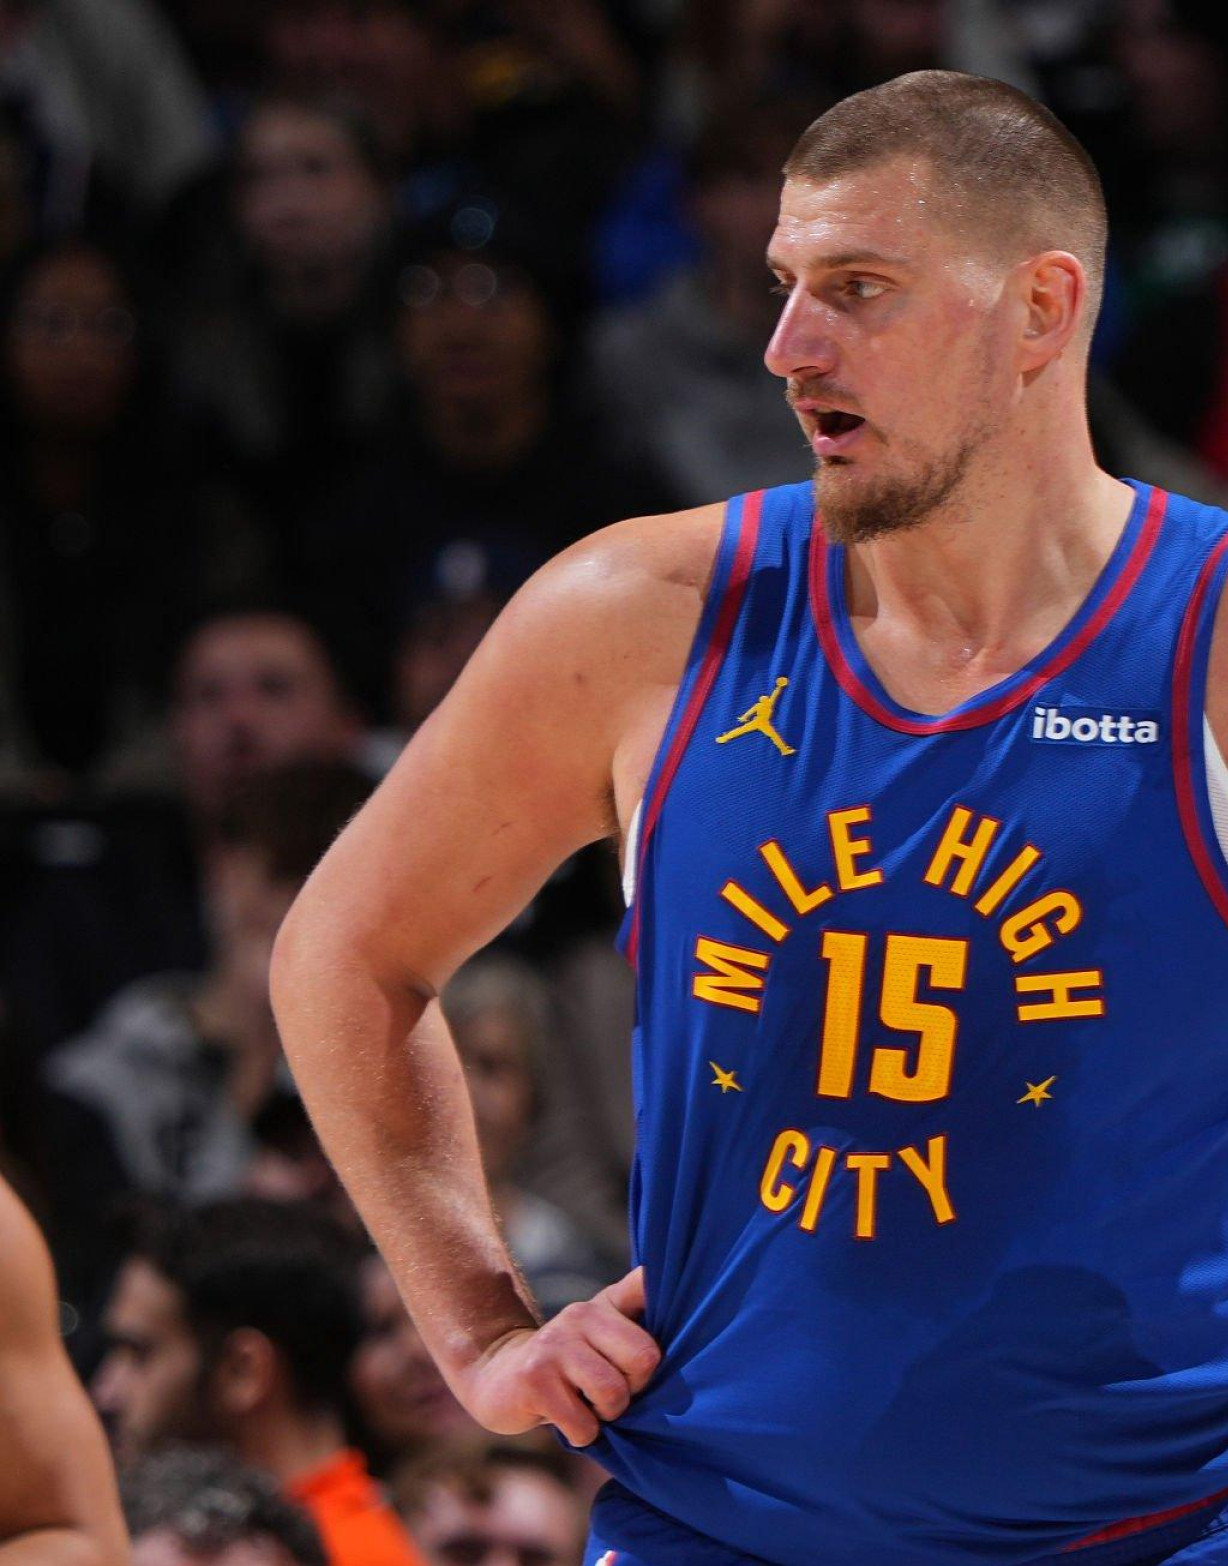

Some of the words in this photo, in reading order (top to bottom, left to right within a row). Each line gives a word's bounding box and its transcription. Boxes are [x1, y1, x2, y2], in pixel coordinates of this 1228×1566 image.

[1032, 706, 1160, 745] ibotta
[691, 804, 884, 1014] MILE
[922, 803, 1106, 1023] HIGH
[816, 929, 970, 1104] 15
[757, 1127, 957, 1241] CITY
